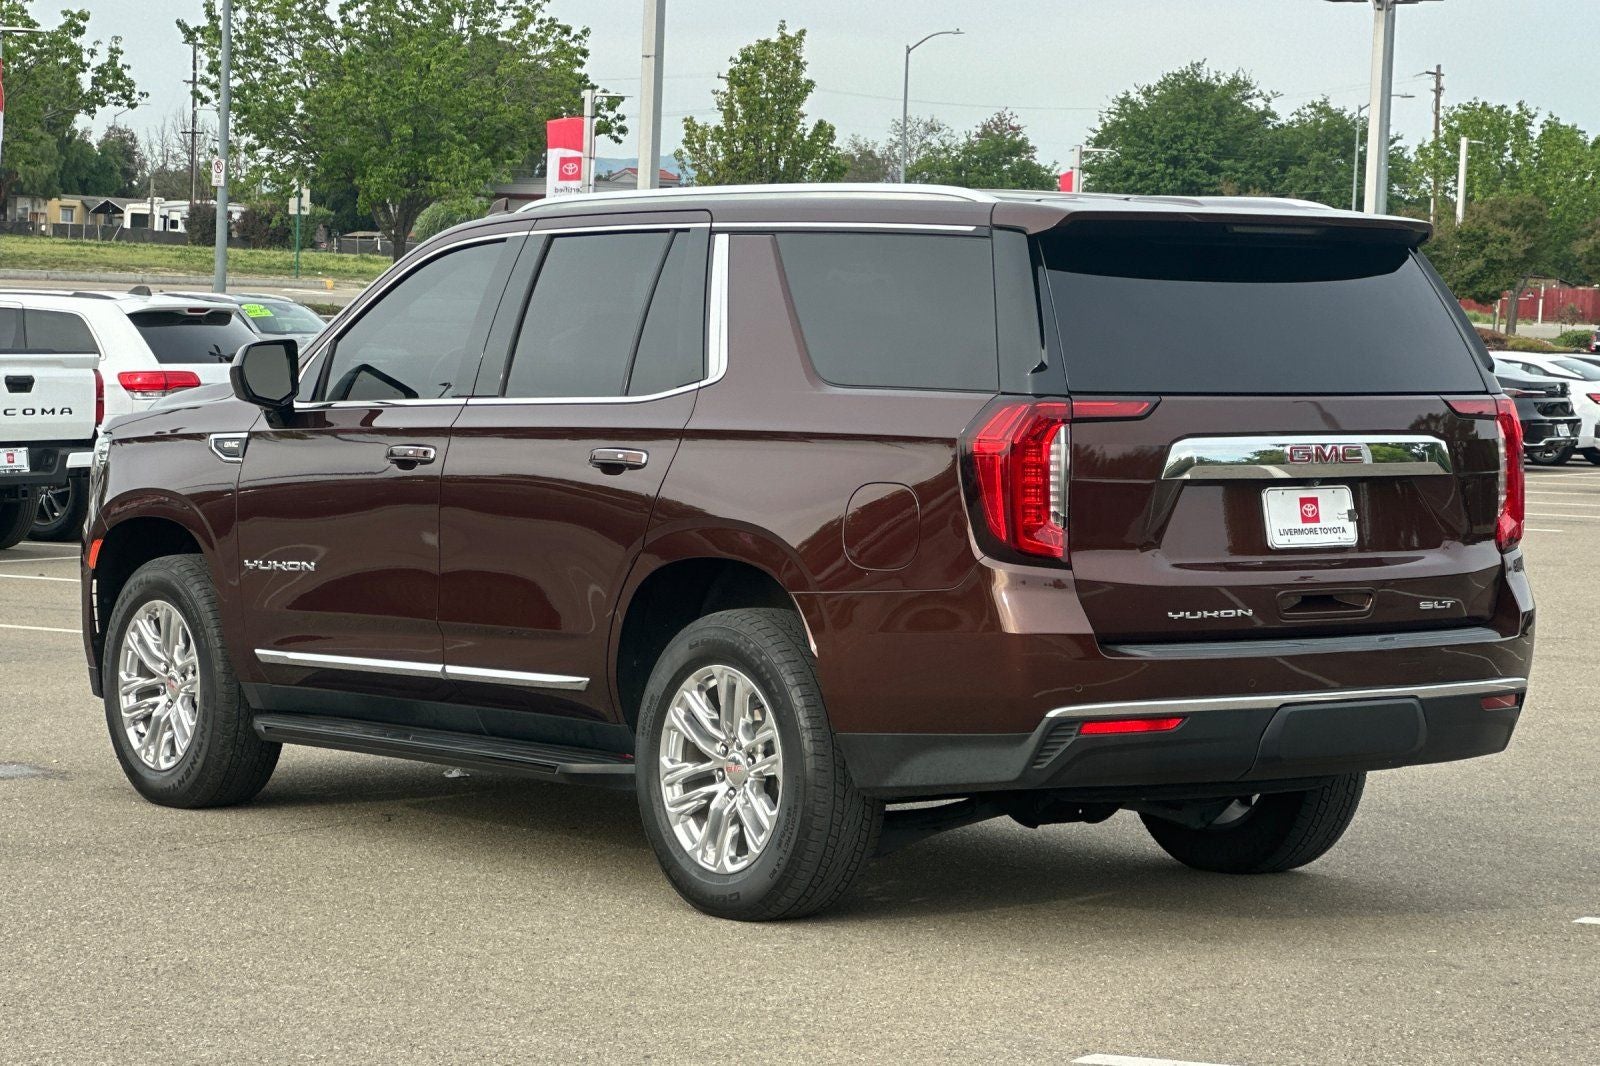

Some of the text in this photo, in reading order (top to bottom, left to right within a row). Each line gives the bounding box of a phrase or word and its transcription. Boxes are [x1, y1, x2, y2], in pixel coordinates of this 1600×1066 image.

[3, 407, 73, 416] COMA
[1288, 443, 1364, 464] GMC
[1278, 526, 1347, 537] LIVERMORE TOYOTA
[243, 559, 316, 571] YUKON
[1419, 600, 1456, 609] SLT
[1167, 609, 1253, 620] YUKON
